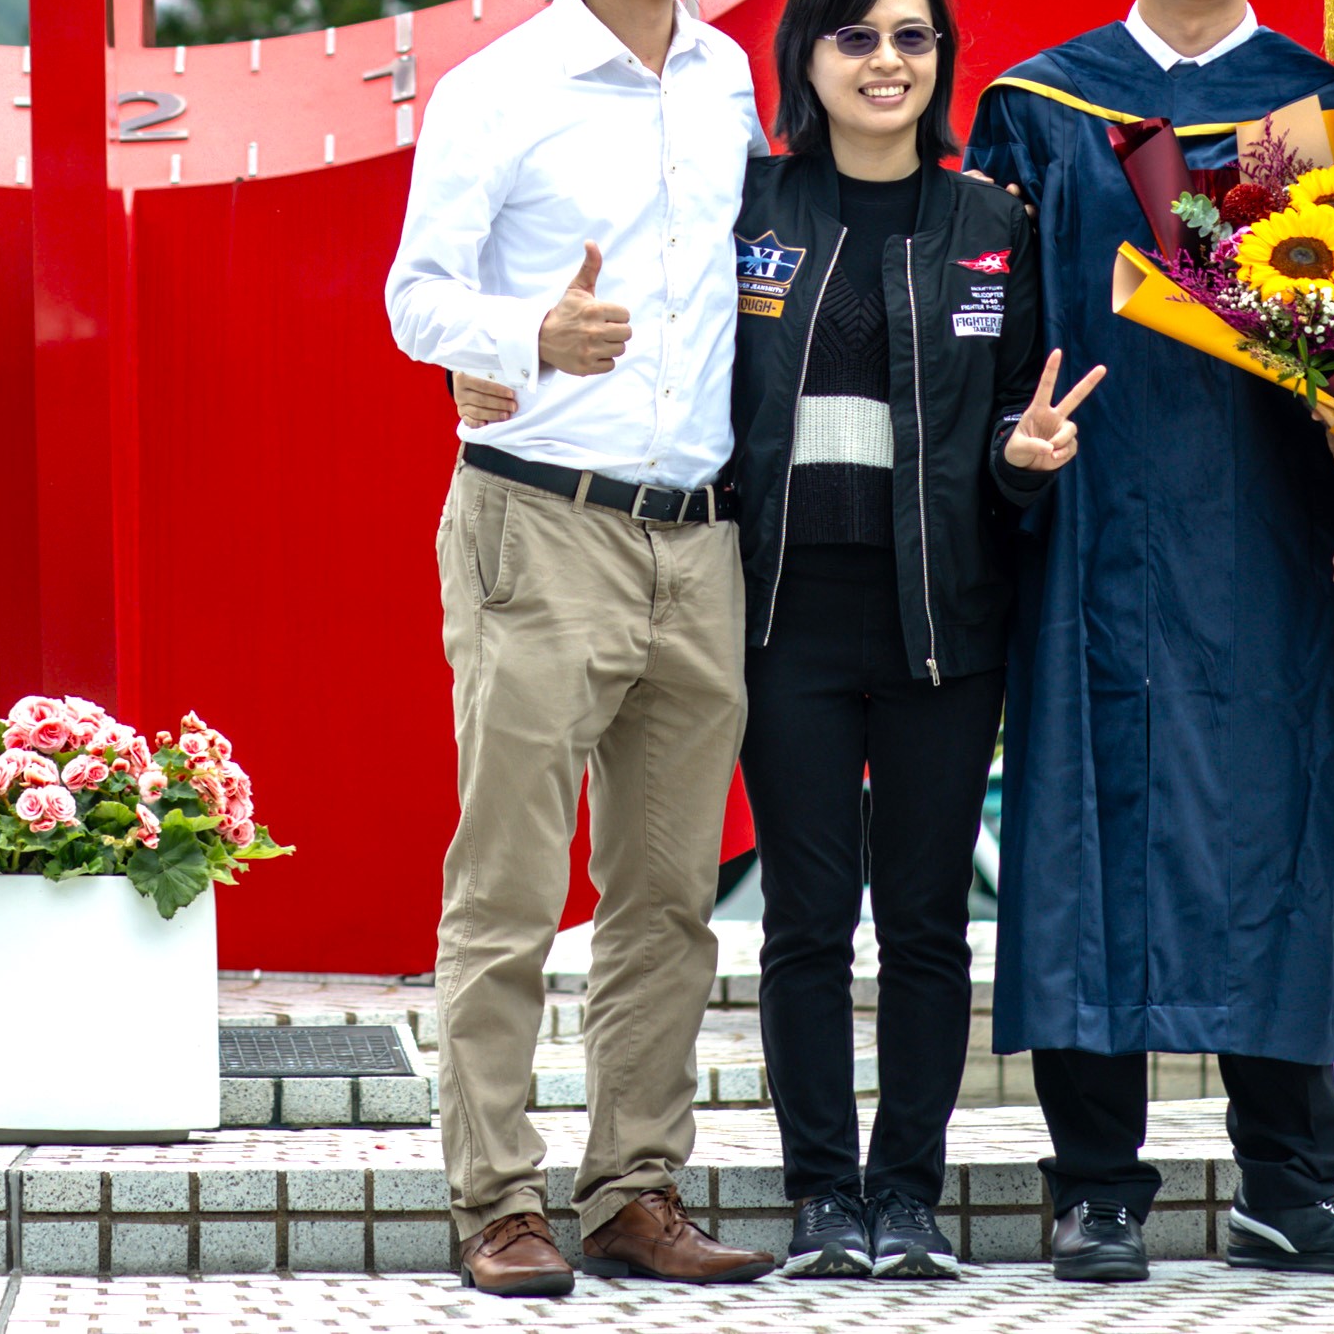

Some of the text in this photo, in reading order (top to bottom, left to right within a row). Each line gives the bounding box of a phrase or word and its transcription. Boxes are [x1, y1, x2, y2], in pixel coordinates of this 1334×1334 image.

[362, 55, 416, 103] 1
[738, 297, 776, 314] OUGH-
[955, 317, 997, 327] FIGHTER
